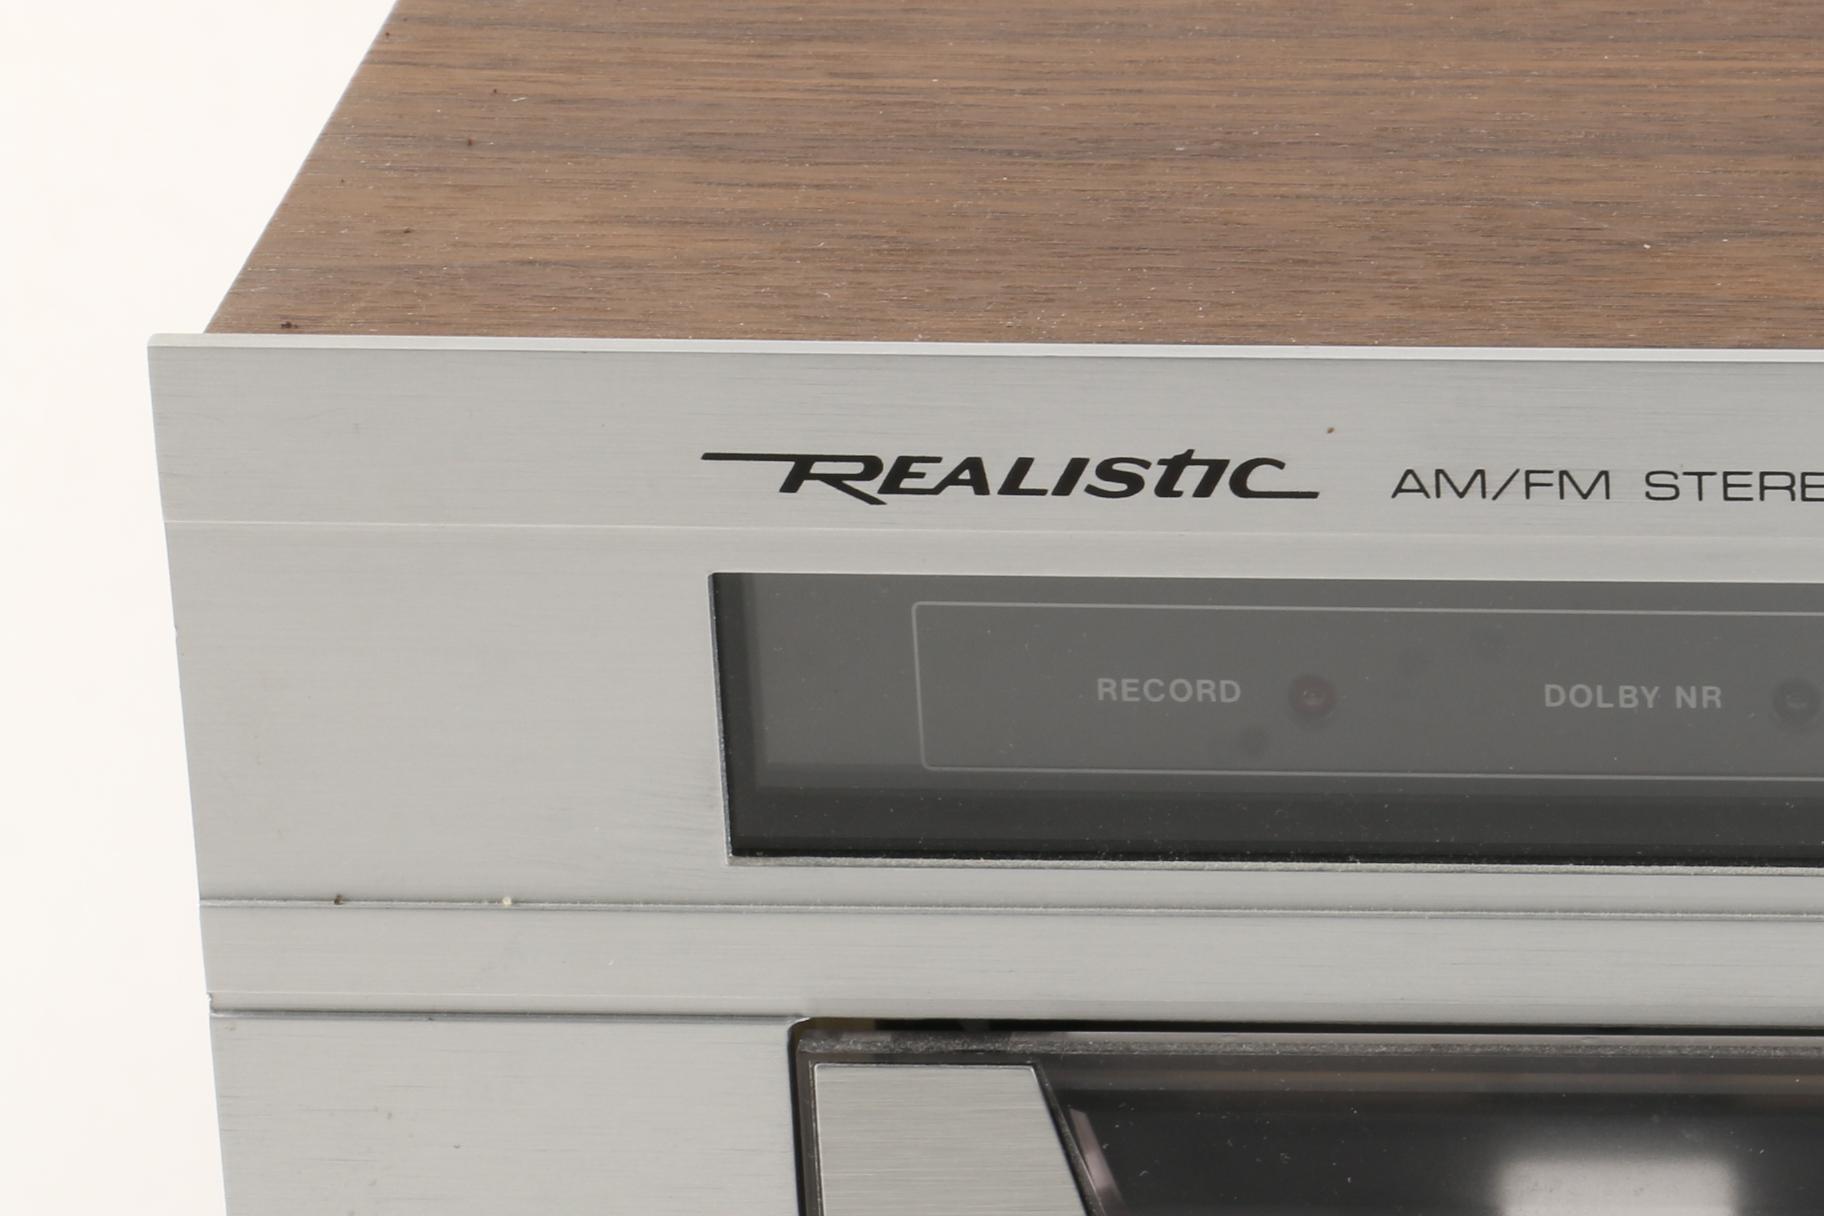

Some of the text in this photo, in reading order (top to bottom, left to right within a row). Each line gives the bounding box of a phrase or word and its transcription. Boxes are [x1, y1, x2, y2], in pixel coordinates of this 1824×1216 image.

[1391, 468, 1611, 501] AM/FM
[1097, 677, 1241, 703] RECORD
[1544, 683, 1722, 709] DOLBY NR
